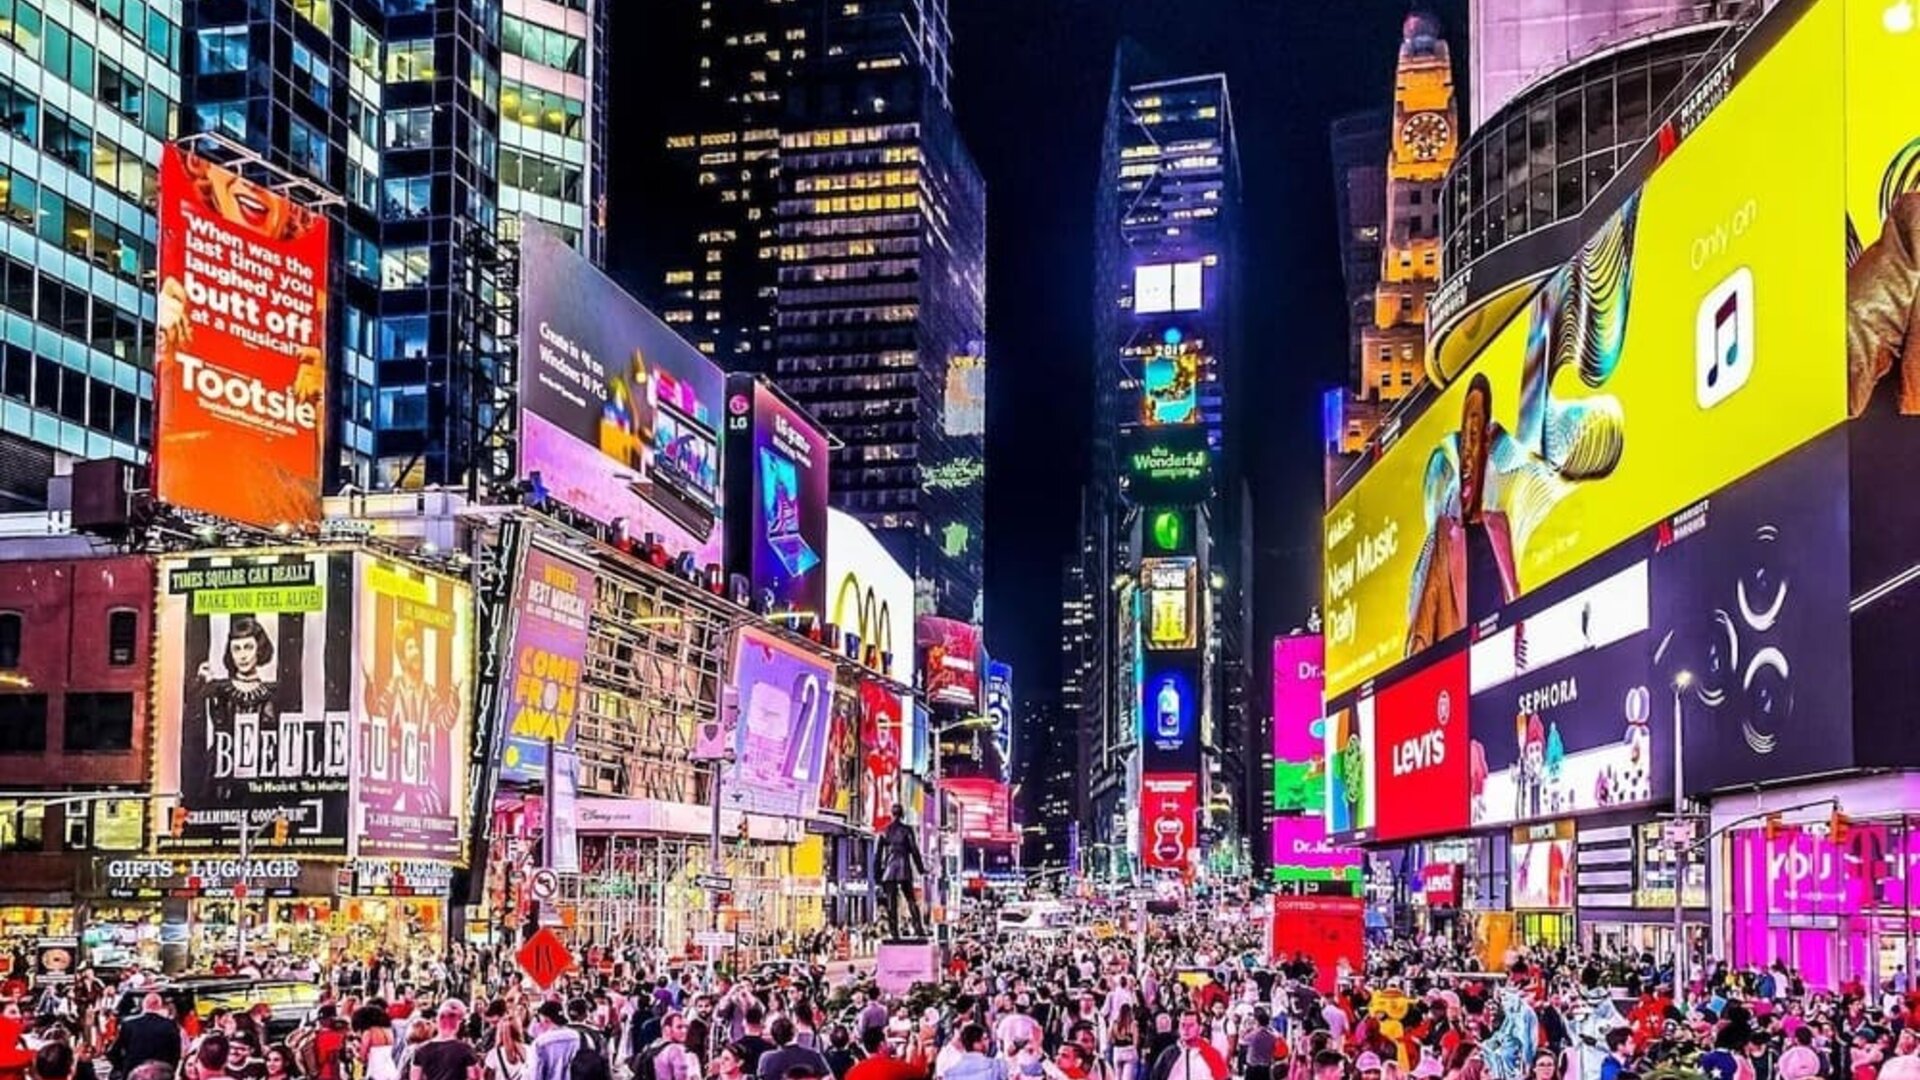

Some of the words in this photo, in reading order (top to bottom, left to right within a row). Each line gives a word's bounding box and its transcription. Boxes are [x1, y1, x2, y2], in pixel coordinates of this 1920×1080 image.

[1681, 52, 1737, 122] MARRIOTT
[1691, 223, 1728, 272] Only
[1732, 199, 1756, 235] on
[186, 229, 223, 261] last
[230, 250, 274, 281] time
[280, 272, 313, 297] you
[249, 241, 282, 267] was
[285, 254, 313, 281] the
[185, 249, 268, 297] laughed
[271, 288, 313, 316] your
[184, 271, 259, 326] butt
[265, 311, 312, 345] off
[190, 308, 211, 326] at
[214, 317, 225, 332] a
[539, 343, 580, 385] Windows
[175, 352, 316, 429] Tootsie
[730, 417, 748, 431] LG
[1134, 452, 1205, 470] Wonderful
[172, 571, 204, 588] TIMES
[205, 568, 246, 588] SQUARE
[248, 567, 269, 584] CAN
[272, 564, 312, 582] REALLY
[1329, 559, 1354, 606] New
[1356, 515, 1398, 584] Music
[199, 592, 228, 610] MAKE
[233, 591, 252, 608] YOU
[256, 590, 283, 608] FEEL
[1329, 598, 1358, 648] Daily
[520, 646, 579, 687] COME
[515, 674, 576, 718] FROM
[1519, 677, 1577, 716] SEPHORA
[510, 705, 571, 745] AWAY
[214, 720, 349, 778] BEETLE
[580, 808, 611, 824] Disney
[109, 860, 174, 878] GIFTS
[191, 858, 300, 878] LUGGAGE
[1772, 852, 1832, 880] YOU
